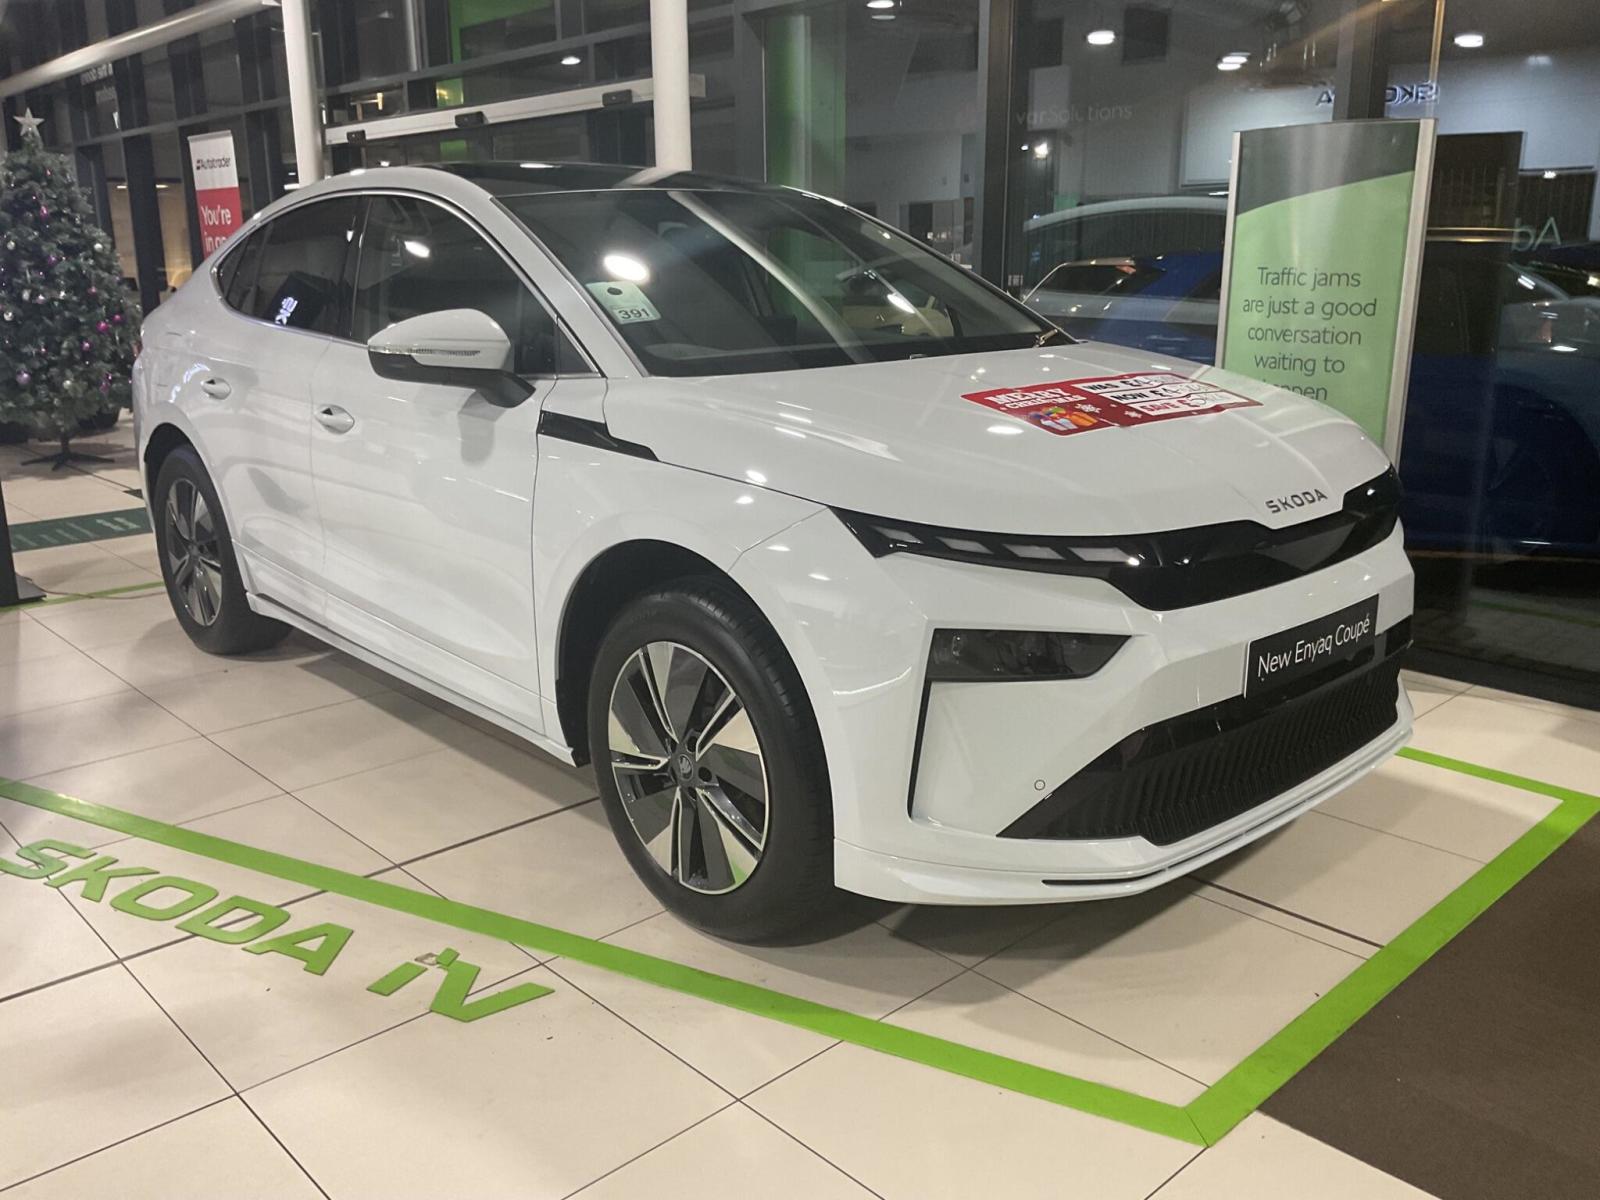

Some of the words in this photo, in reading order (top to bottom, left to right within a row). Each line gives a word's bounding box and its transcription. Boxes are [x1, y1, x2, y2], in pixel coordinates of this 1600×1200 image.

[201, 204, 232, 226] You're
[1257, 266, 1307, 286] Traffic
[1311, 268, 1361, 292] jams
[618, 308, 650, 319] 391
[1242, 298, 1264, 313] are
[1267, 296, 1299, 319] just
[1304, 301, 1315, 315] a
[1321, 298, 1377, 320] good
[1248, 326, 1362, 345] conversation
[1254, 353, 1316, 377] waiting
[1324, 357, 1345, 373] to
[984, 387, 1072, 405] MERRY
[1082, 382, 1119, 391] WAS
[1110, 392, 1148, 401] NOW
[1139, 402, 1180, 412] SAVE
[1265, 488, 1328, 514] SKODA
[1257, 648, 1292, 678] New
[1295, 636, 1333, 663] Enyaq
[1335, 612, 1371, 647] Coupé
[0, 839, 354, 976] SKODA
